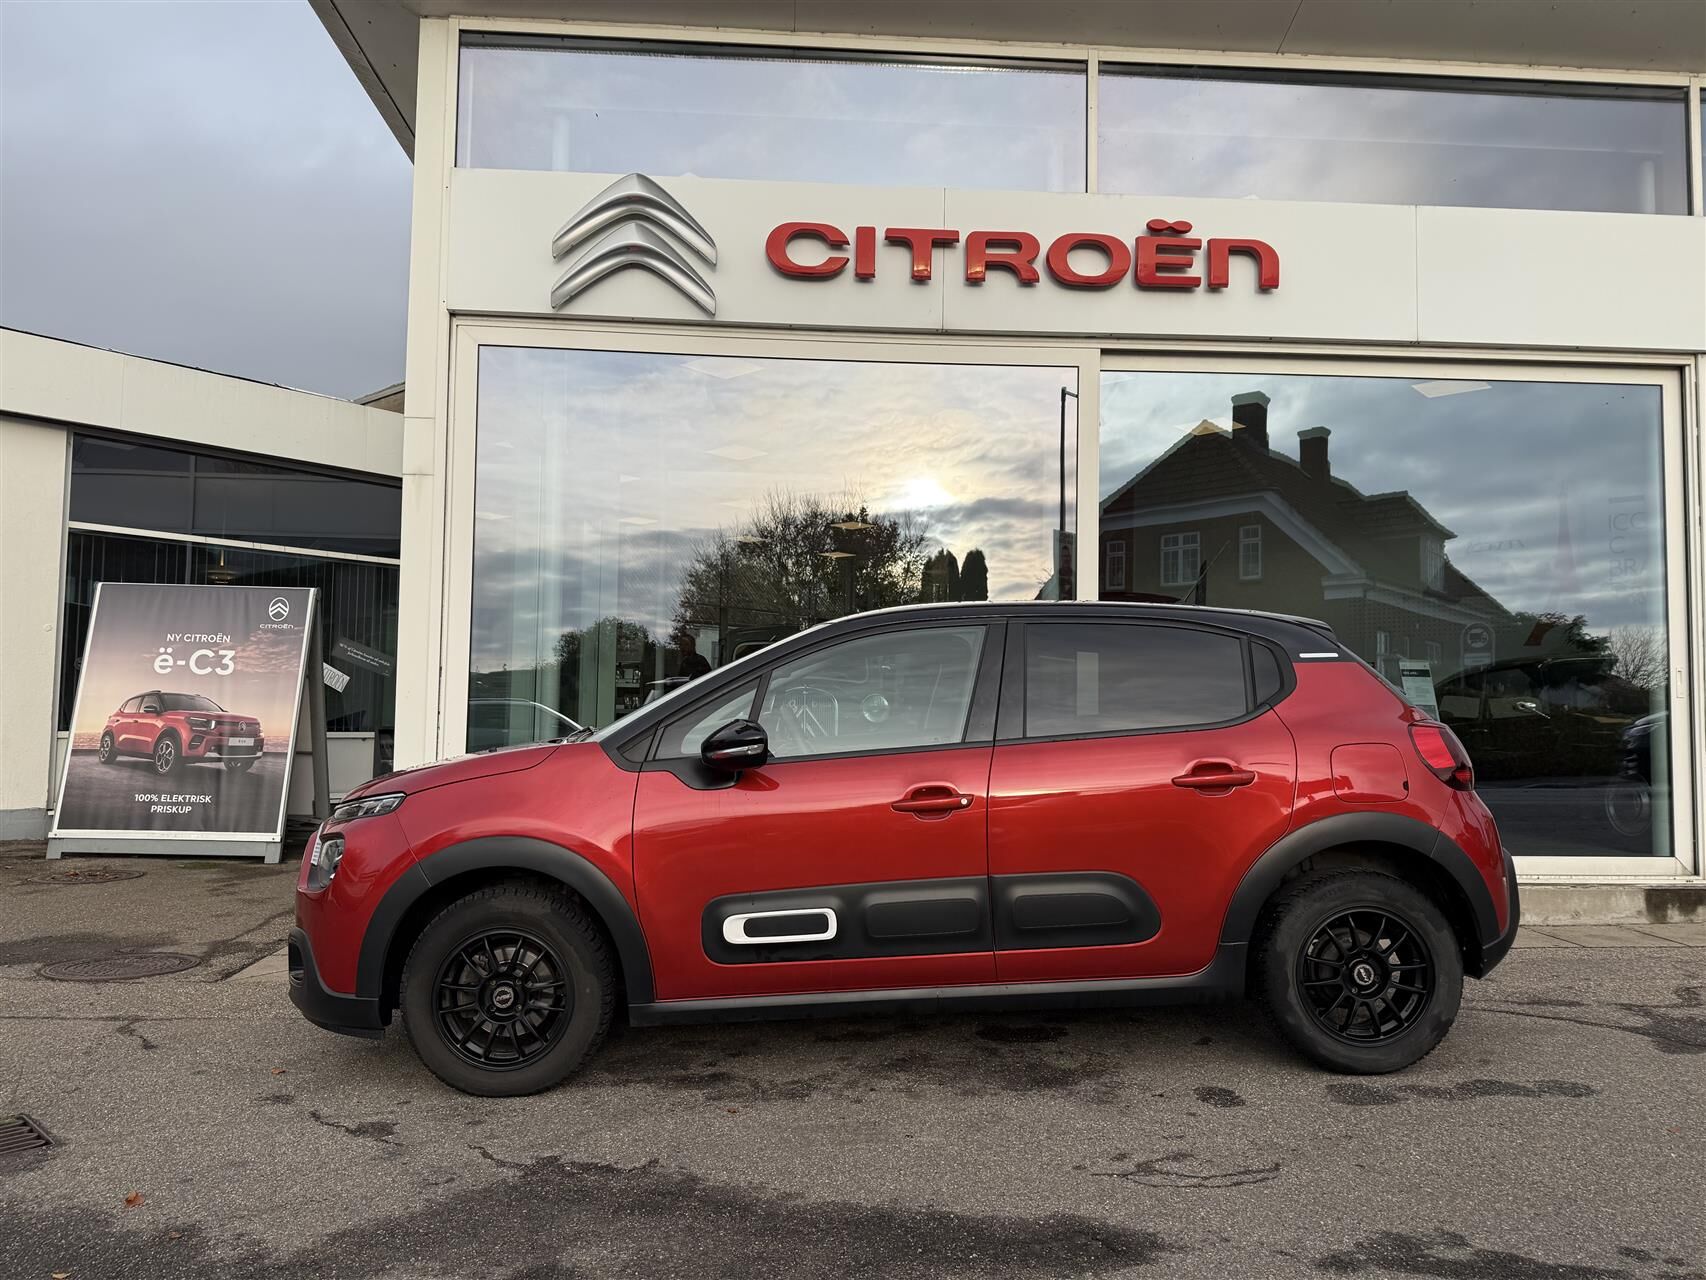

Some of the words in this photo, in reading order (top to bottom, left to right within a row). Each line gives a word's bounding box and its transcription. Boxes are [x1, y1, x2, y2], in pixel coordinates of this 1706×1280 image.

[766, 219, 1280, 290] CITROËN
[166, 633, 182, 642] NY
[184, 633, 231, 643] CITROËN
[153, 647, 236, 676] ë-C3
[135, 794, 159, 802] 100%
[161, 794, 212, 803] ELEKTRISK
[151, 805, 192, 814] PRISKUP
